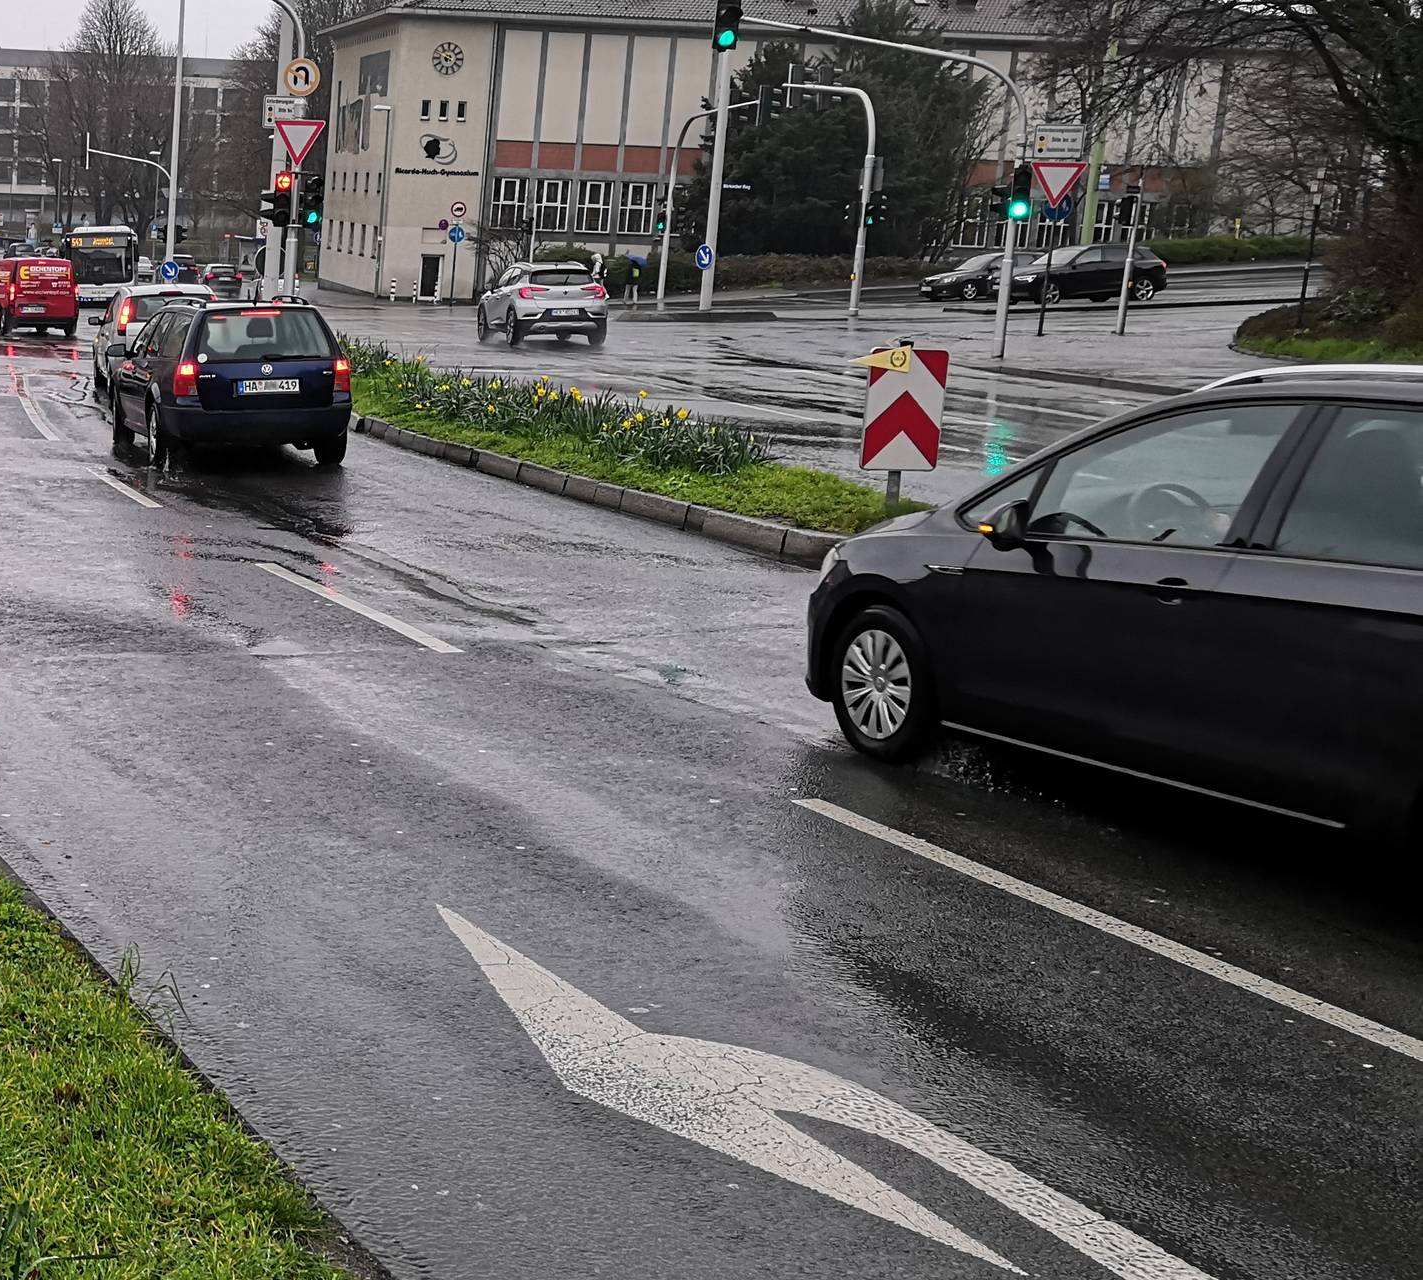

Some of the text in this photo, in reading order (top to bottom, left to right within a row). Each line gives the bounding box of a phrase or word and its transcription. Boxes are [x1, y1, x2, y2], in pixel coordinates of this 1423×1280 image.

[395, 168, 480, 177] Ricarda-Huch-Gymnasium
[71, 237, 83, 247] 543
[244, 380, 298, 391] HA 419
